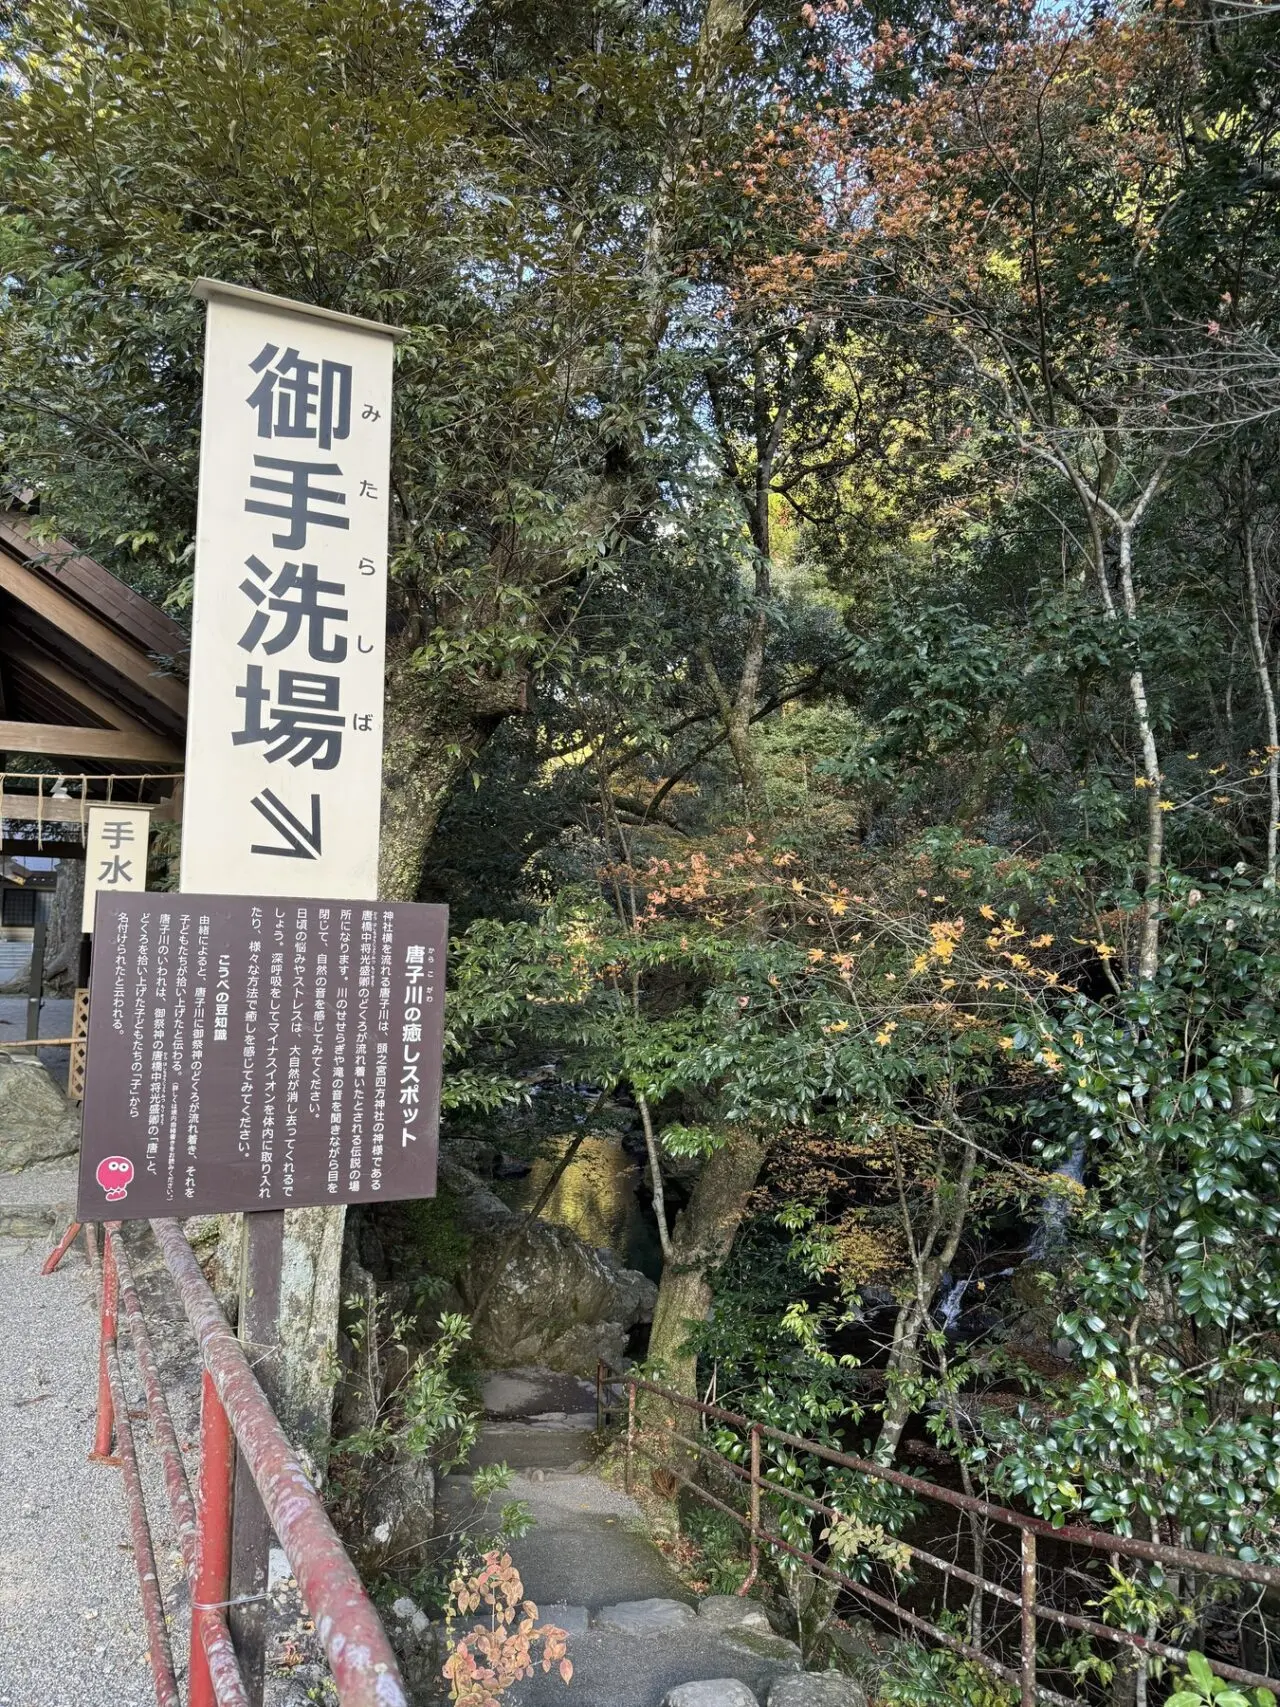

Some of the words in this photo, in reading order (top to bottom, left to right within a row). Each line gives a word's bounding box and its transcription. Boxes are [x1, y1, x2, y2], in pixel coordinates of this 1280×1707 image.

[232, 342, 353, 771] 御手洗場
[352, 403, 381, 734] みたらしば
[98, 820, 135, 891] 手水
[112, 912, 129, 1035] 名付けられたと云われる。
[213, 954, 231, 1041] こうべの豆知識
[399, 944, 426, 1148] 唐子川の癒しスポット
